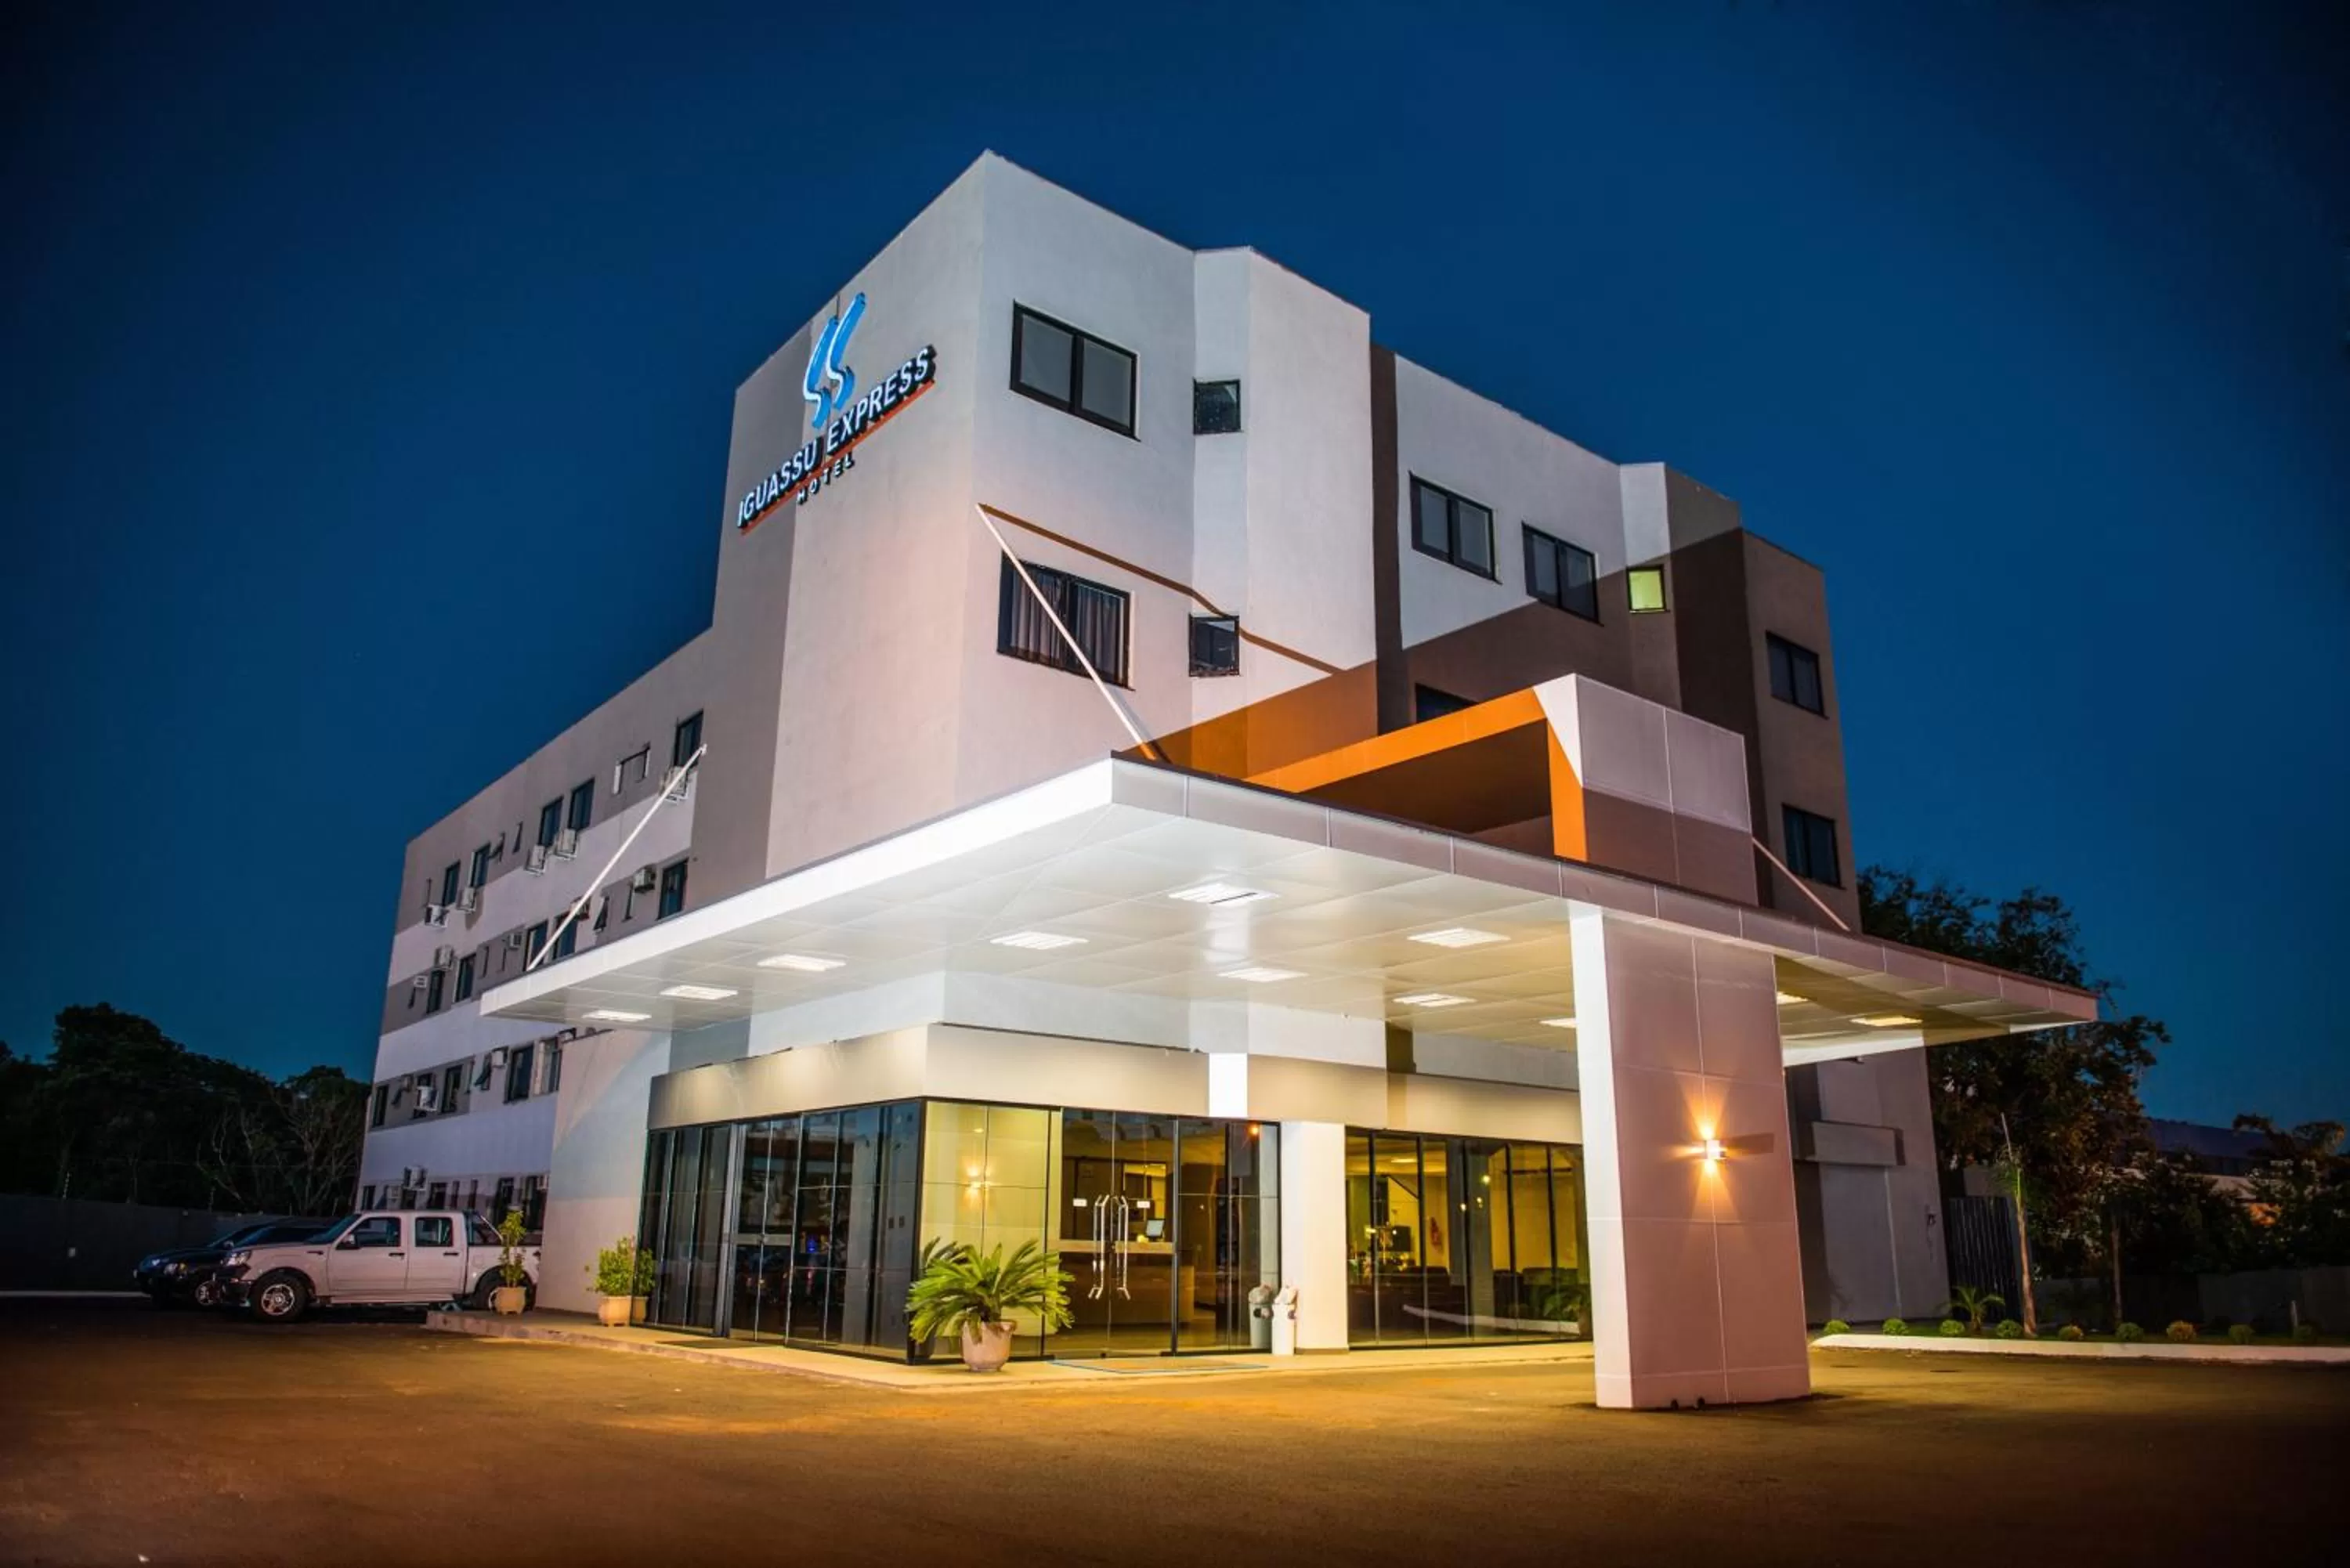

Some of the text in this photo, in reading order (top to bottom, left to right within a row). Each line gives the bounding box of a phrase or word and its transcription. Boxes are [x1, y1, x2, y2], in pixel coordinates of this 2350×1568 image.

[737, 345, 935, 528] IGUASSU EXPRESS
[796, 453, 854, 505] HOTEL
